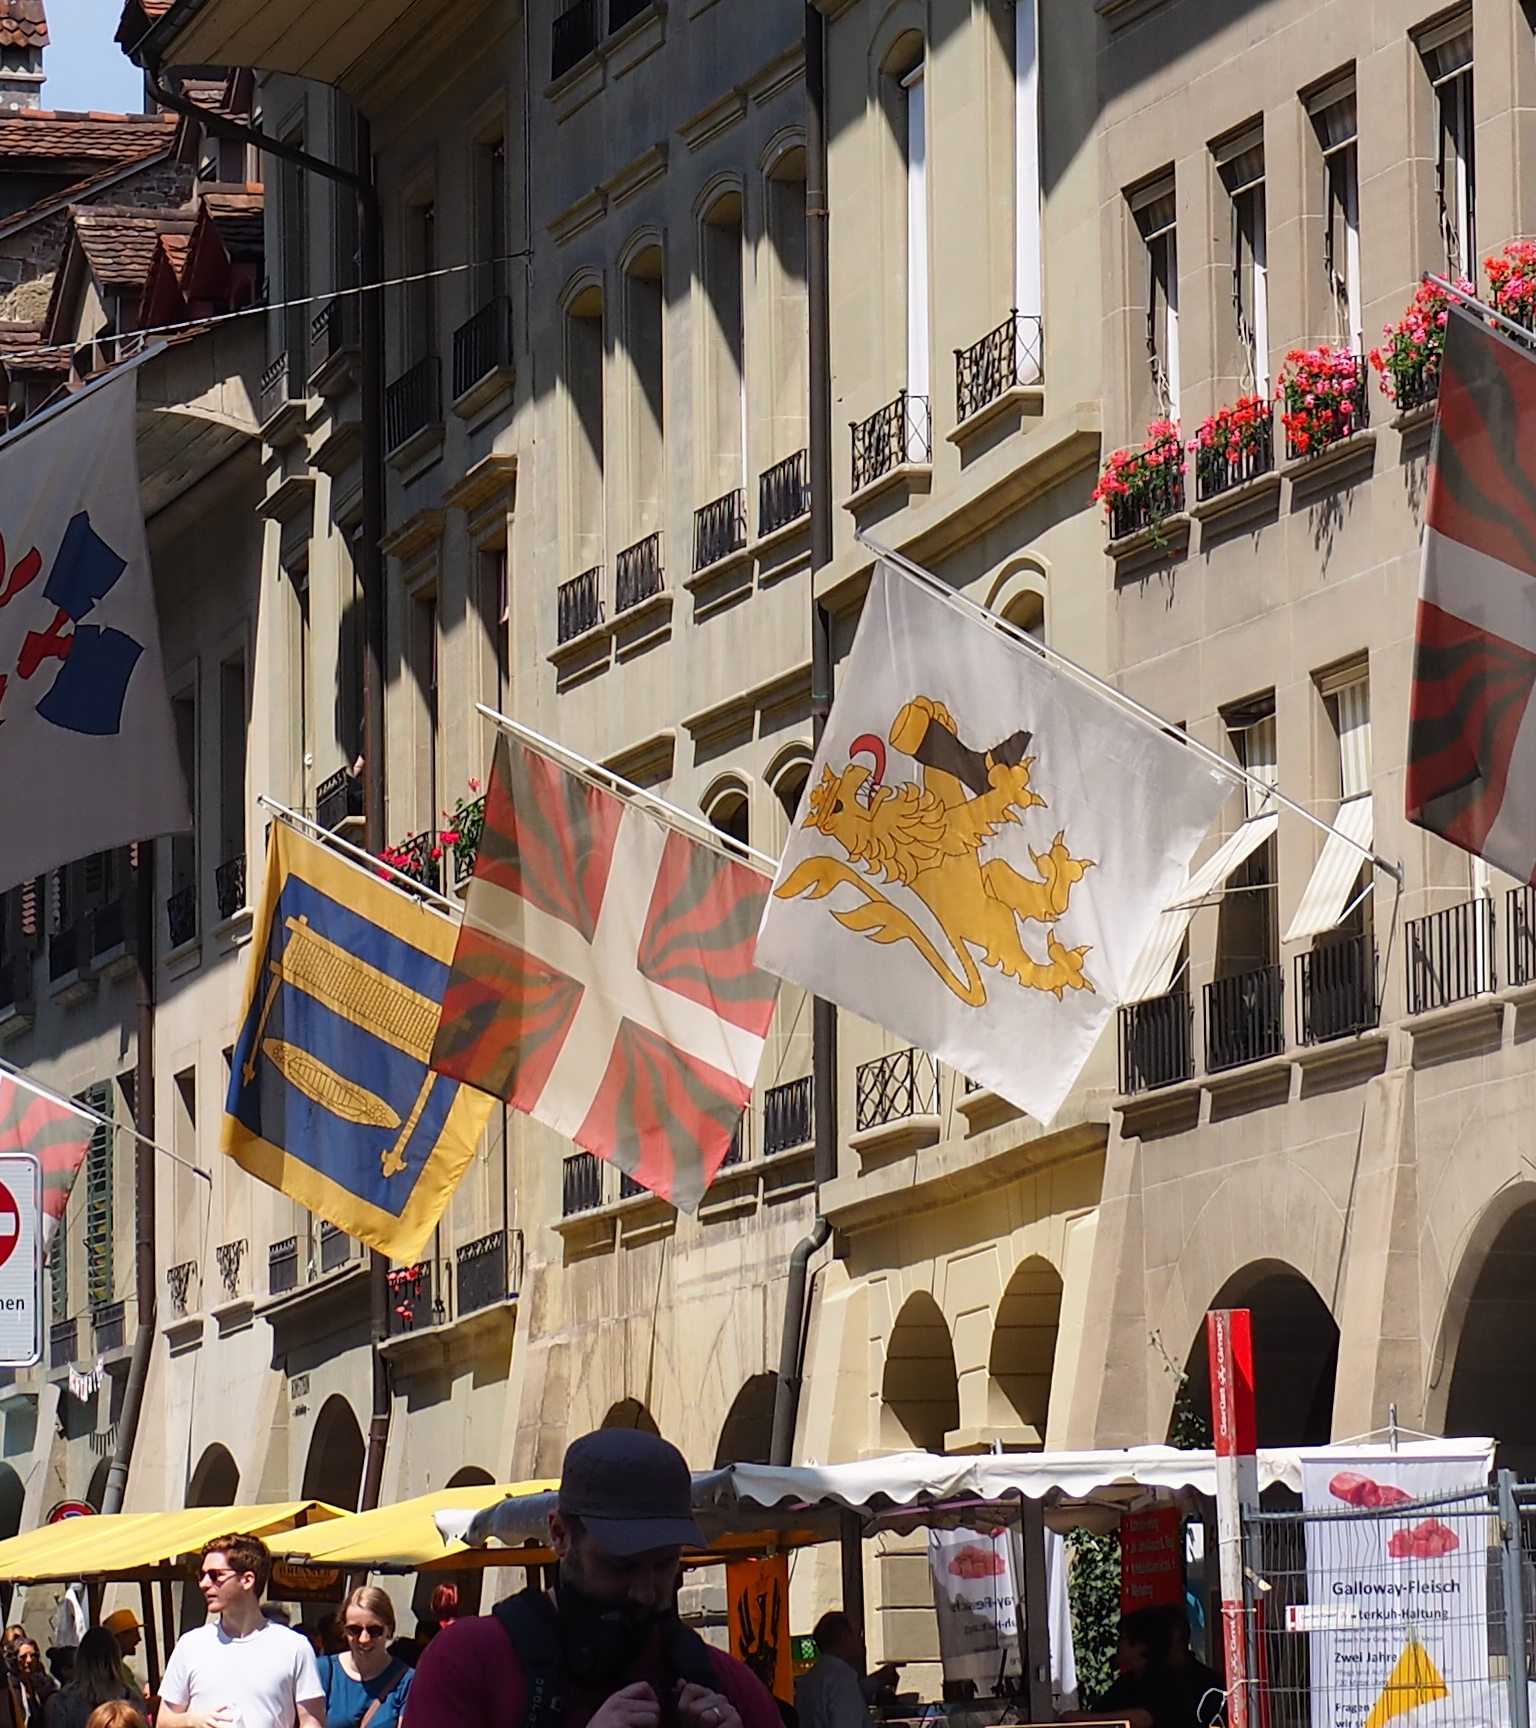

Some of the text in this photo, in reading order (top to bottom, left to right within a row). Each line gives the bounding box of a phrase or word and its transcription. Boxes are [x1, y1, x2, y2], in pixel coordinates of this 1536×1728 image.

[1332, 1578, 1461, 1597] Galloway-Fleisch
[1351, 1607, 1449, 1621] terkuh-Haltung
[1334, 1651, 1398, 1663] Zwei Jahre
[1335, 1702, 1370, 1714] Fragen
